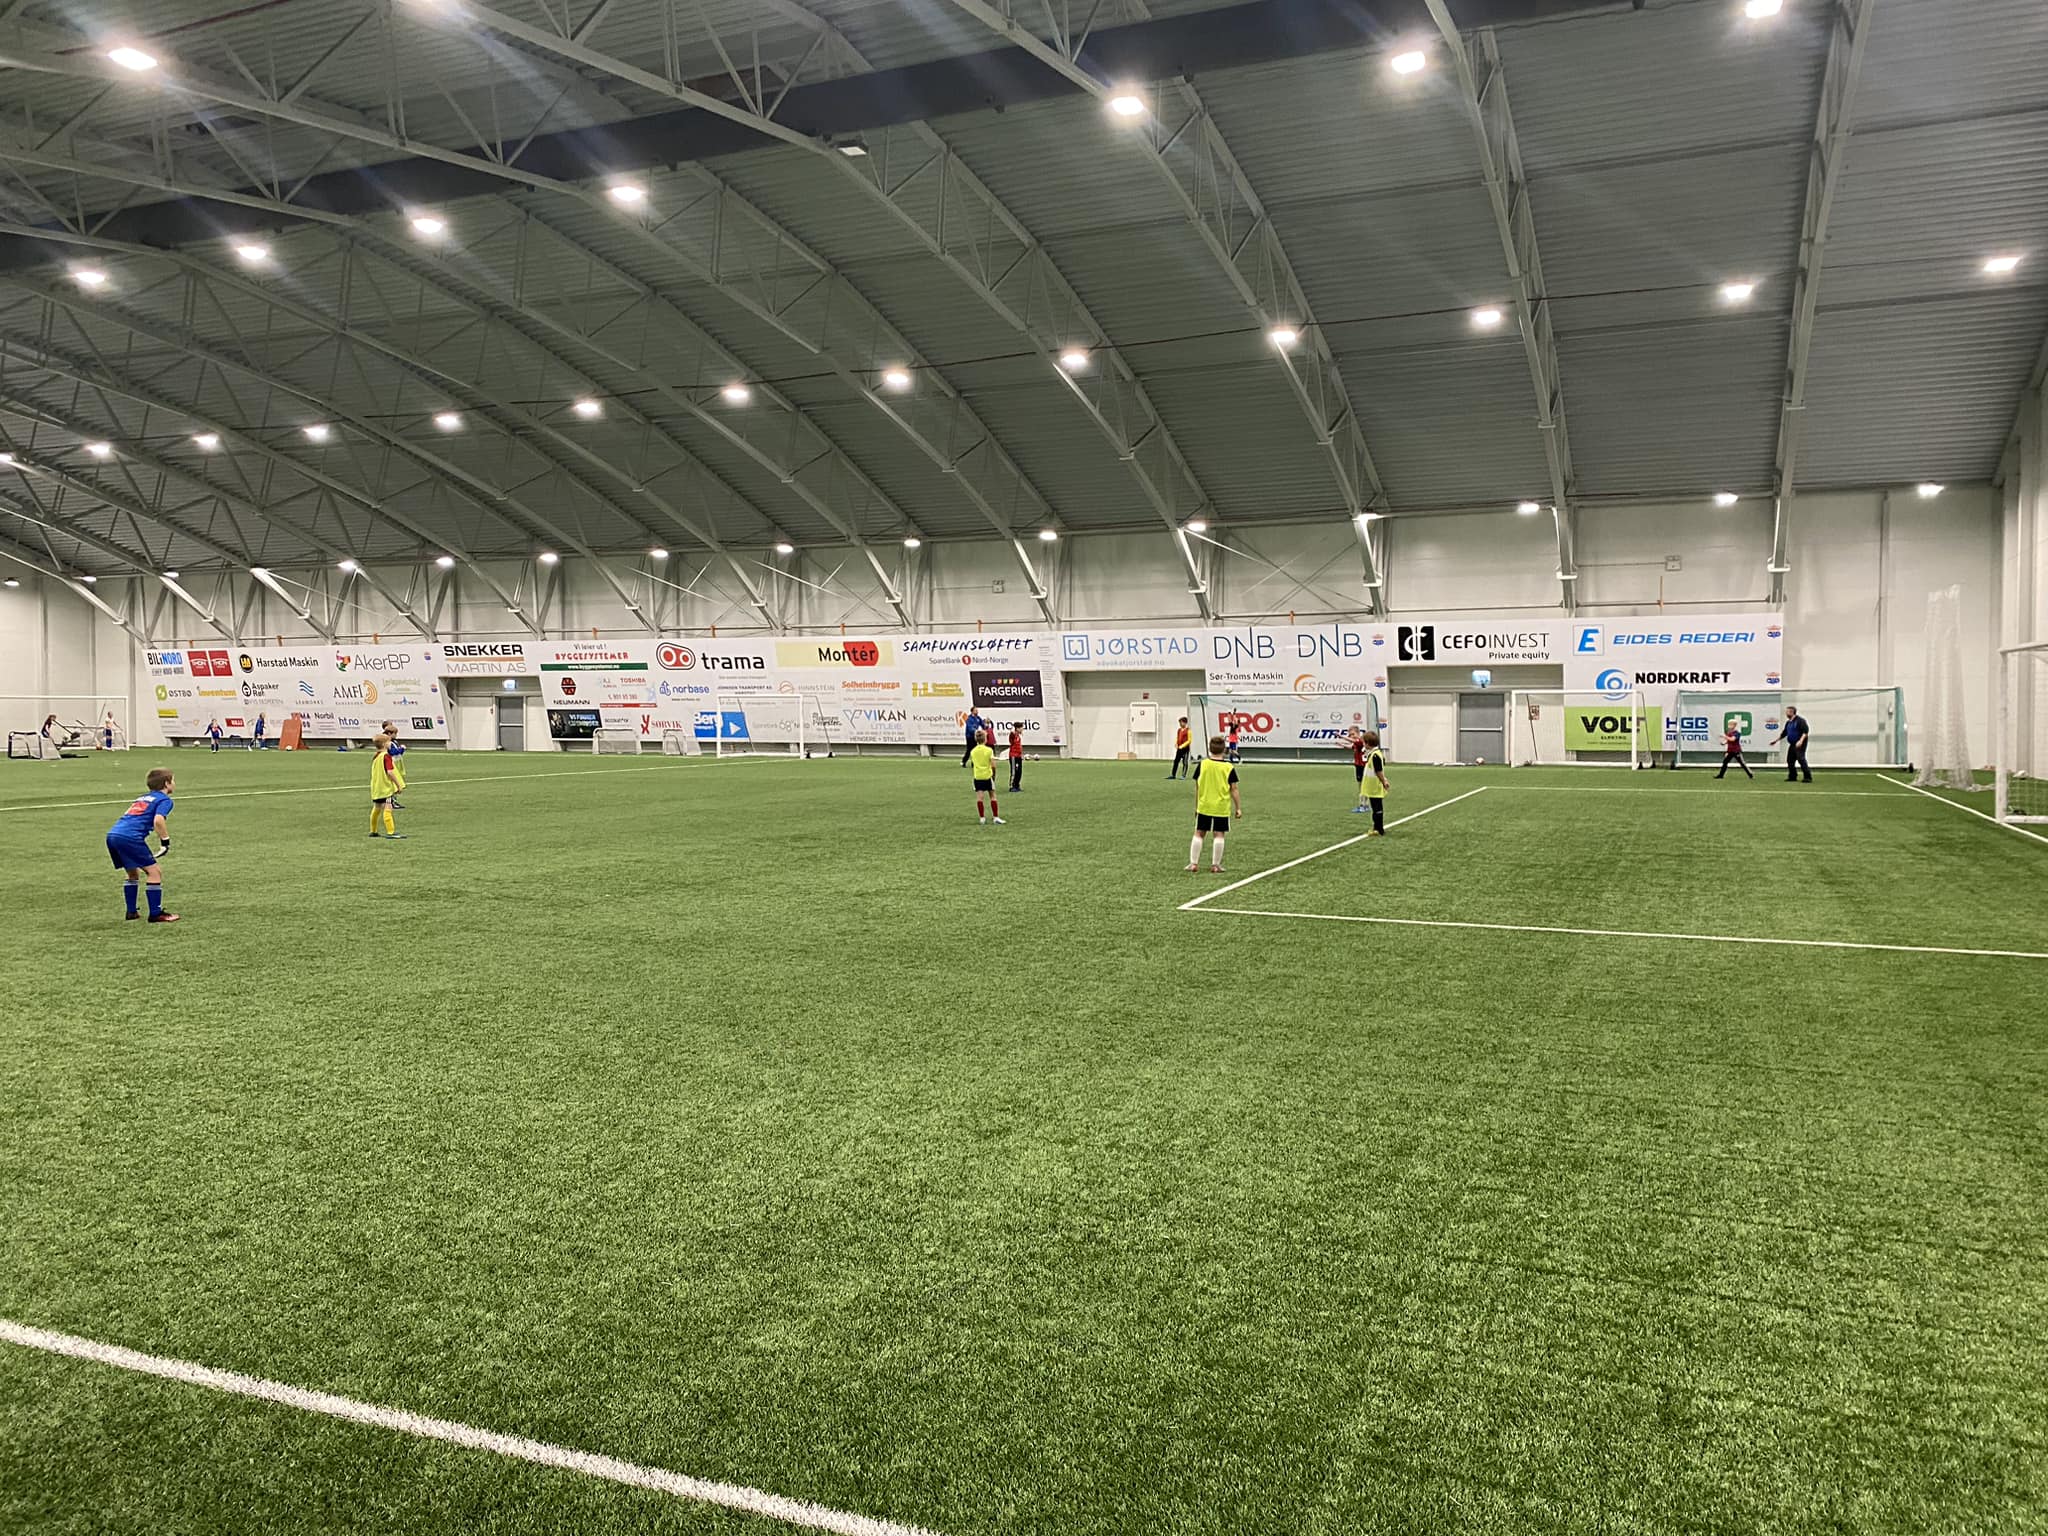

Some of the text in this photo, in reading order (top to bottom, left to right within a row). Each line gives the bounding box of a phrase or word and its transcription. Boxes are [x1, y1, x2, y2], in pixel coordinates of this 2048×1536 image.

[1442, 633, 1550, 649] CEFOINVEST
[1612, 632, 1755, 645] EIDES REDERI
[443, 644, 524, 656] SNEKKER
[903, 639, 1033, 652] SAMFUNNSLØFTET
[1095, 637, 1198, 656] JØRSTAD
[1213, 626, 1275, 667] DNB
[1297, 624, 1362, 667] DNB
[256, 657, 287, 668] Harstad
[289, 656, 319, 667] Maskin
[701, 652, 765, 670] trama
[972, 656, 1008, 665] Nord-Norge
[1488, 651, 1550, 661] Private equity
[447, 663, 527, 673] MARTIN AS
[1209, 672, 1284, 681] Sør-Troms Maskin
[1635, 671, 1731, 685] NORDKRAFT
[333, 684, 364, 698] AMFI
[672, 684, 709, 693] norbase
[979, 686, 1035, 696] FARGERIKE
[864, 710, 907, 721] VIKAN
[1666, 717, 1709, 728] HGB
